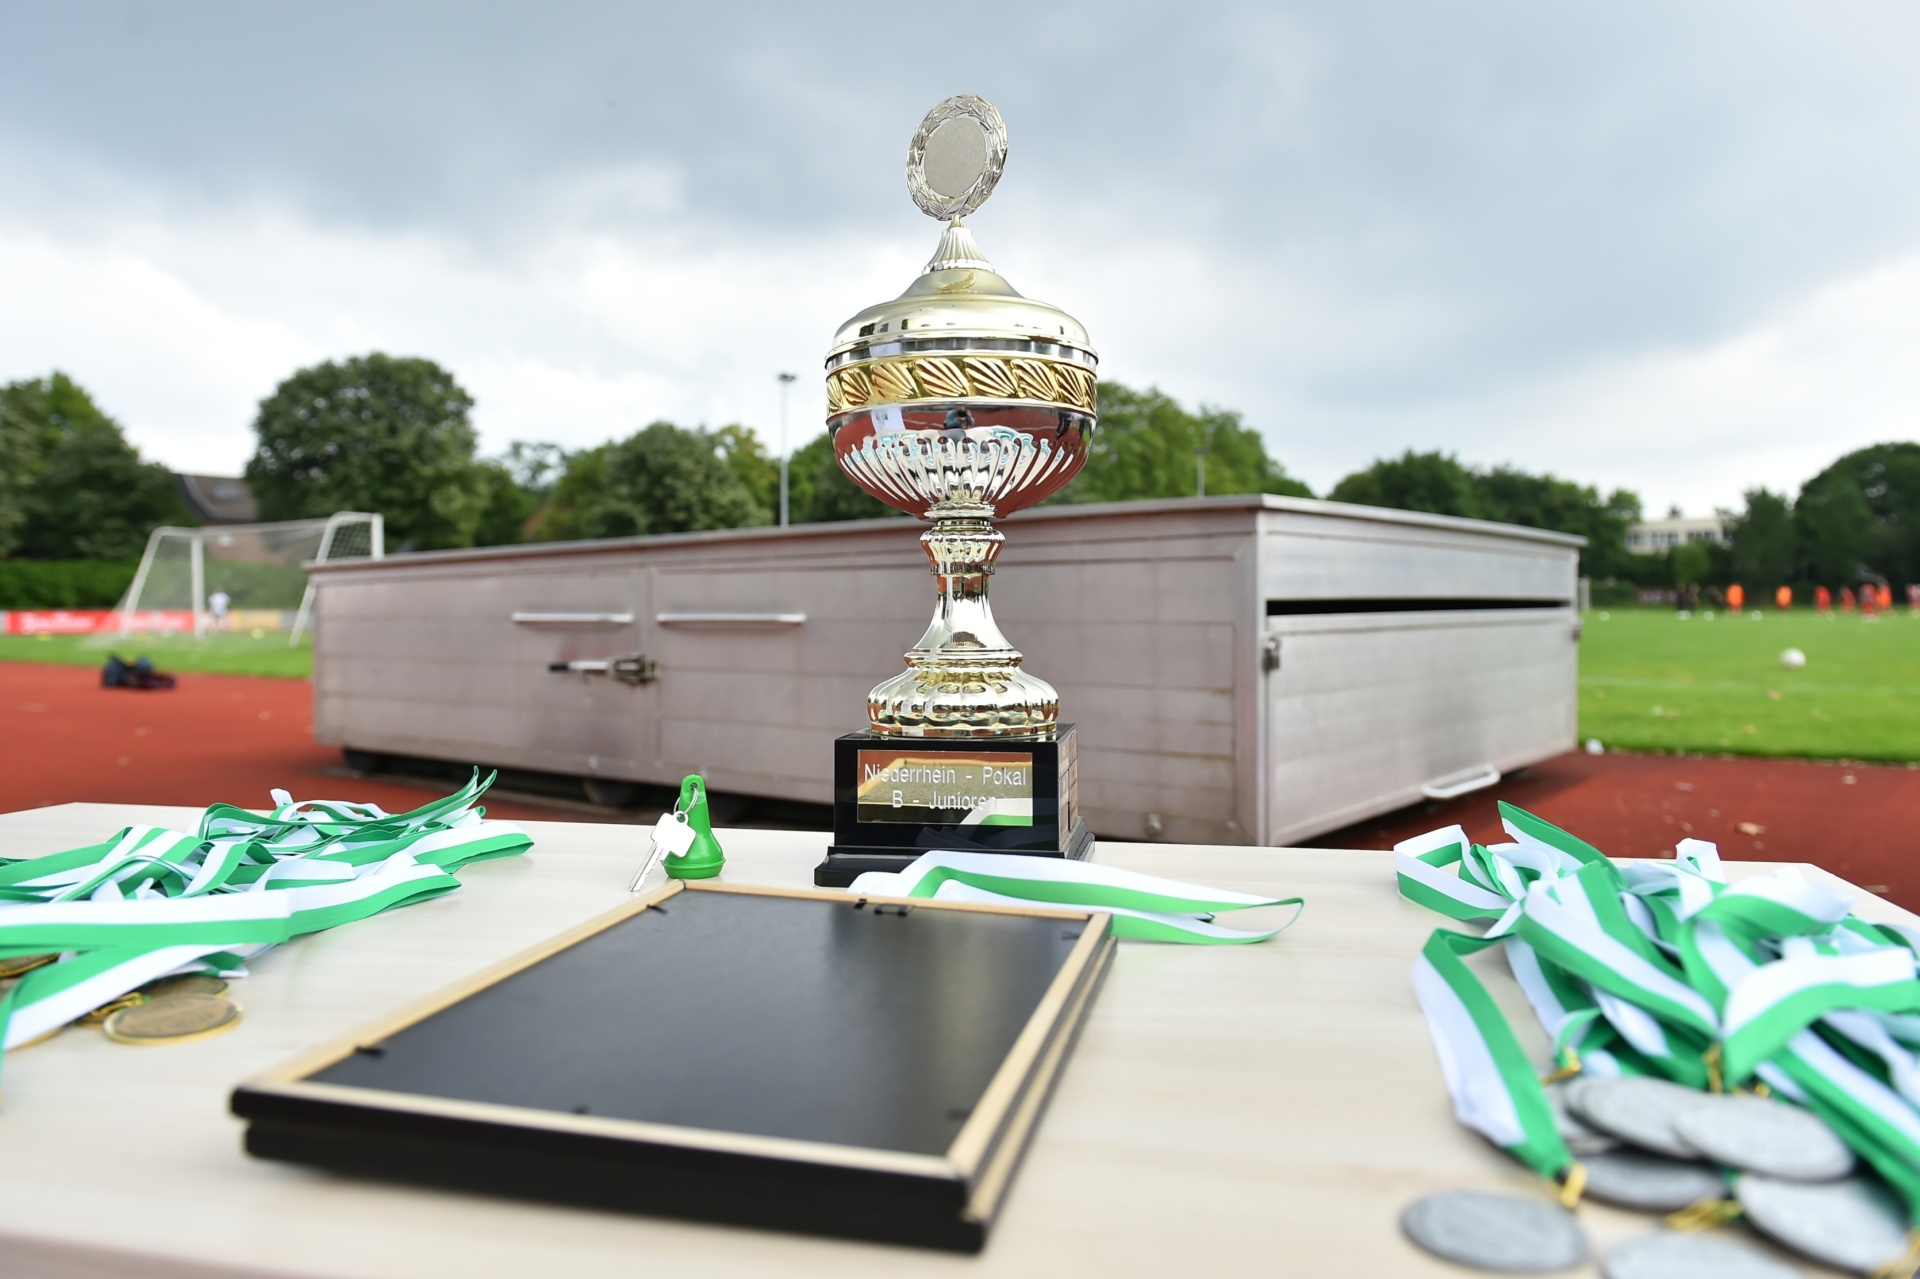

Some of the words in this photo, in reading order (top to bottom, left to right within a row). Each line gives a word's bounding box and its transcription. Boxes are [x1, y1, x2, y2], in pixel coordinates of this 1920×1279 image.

[864, 763, 956, 784] Niederrhein
[982, 766, 1027, 786] Pokal
[892, 790, 904, 808] B
